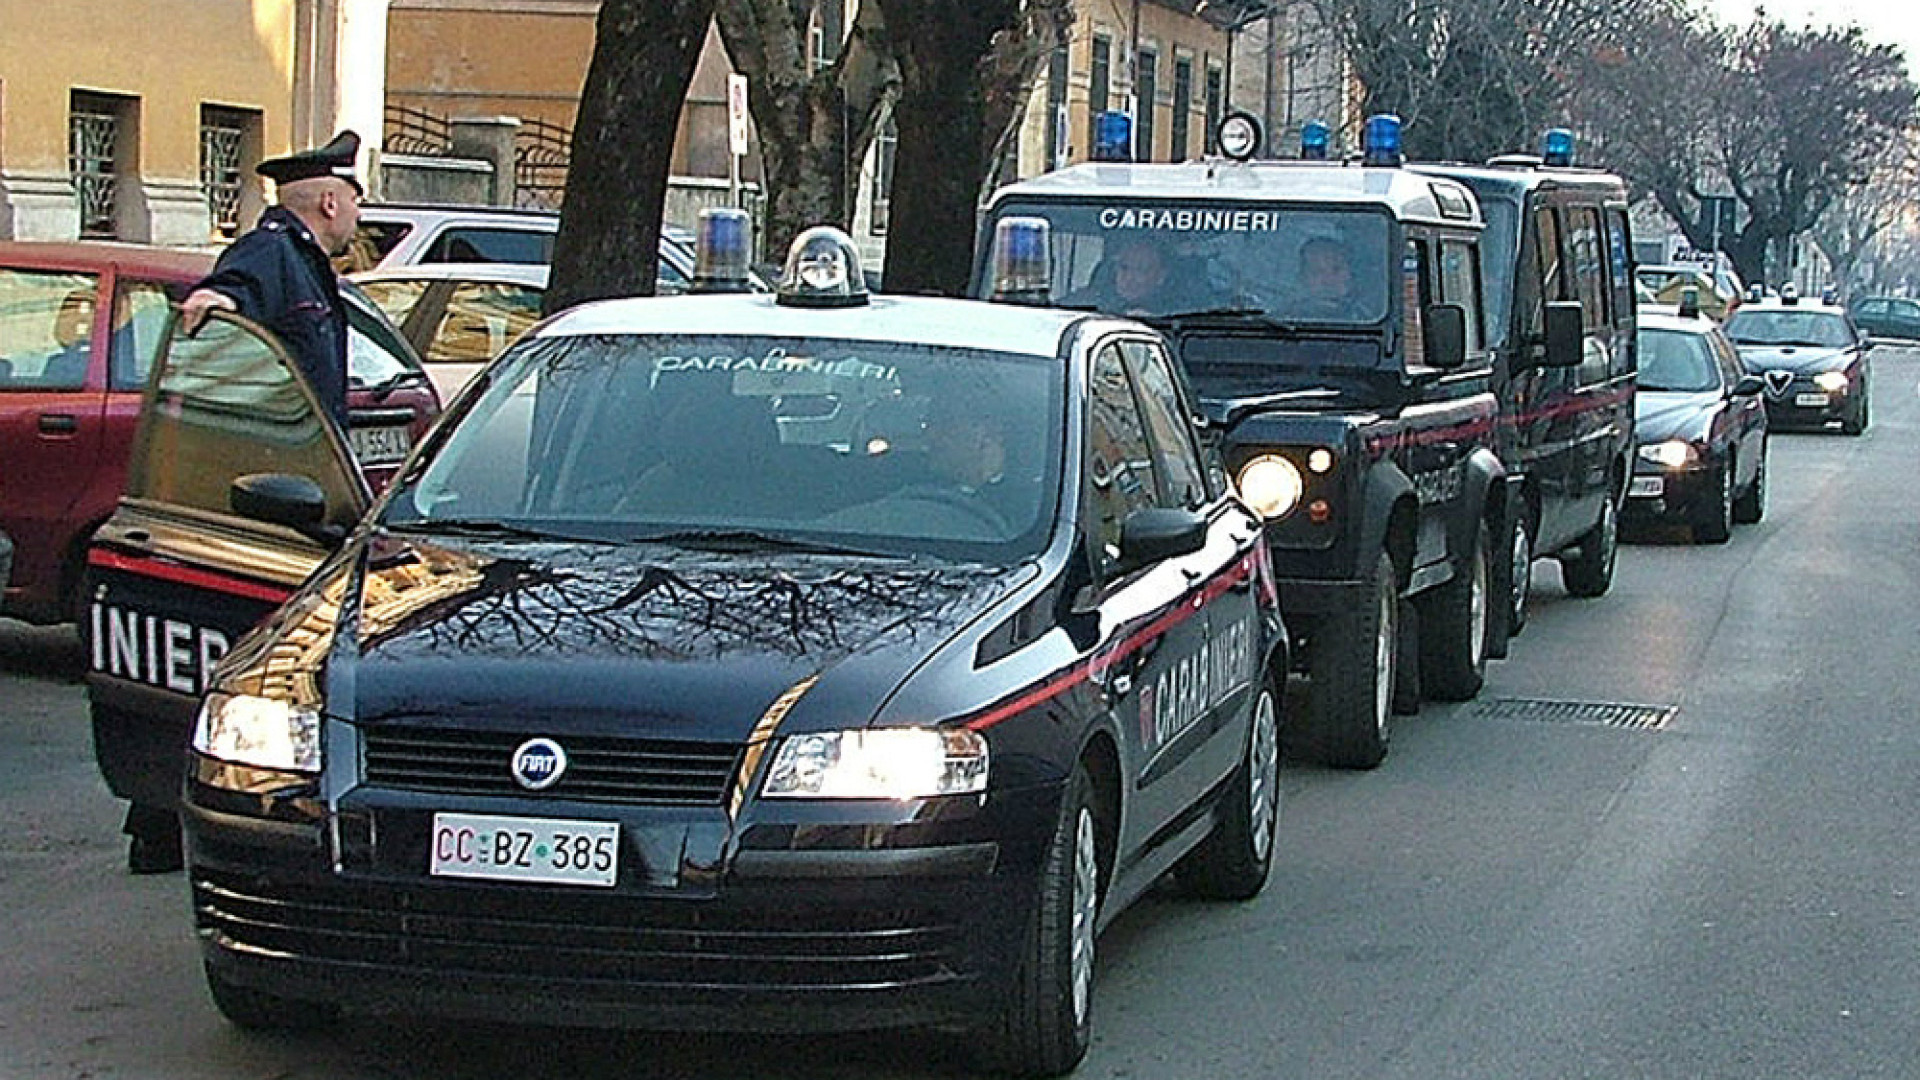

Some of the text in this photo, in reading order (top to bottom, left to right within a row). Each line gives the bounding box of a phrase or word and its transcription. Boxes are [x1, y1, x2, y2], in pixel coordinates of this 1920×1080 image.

[1100, 208, 1279, 231] CARABINIERI
[520, 755, 556, 773] FIAT
[494, 830, 534, 868] BZ
[552, 833, 613, 872] 385
